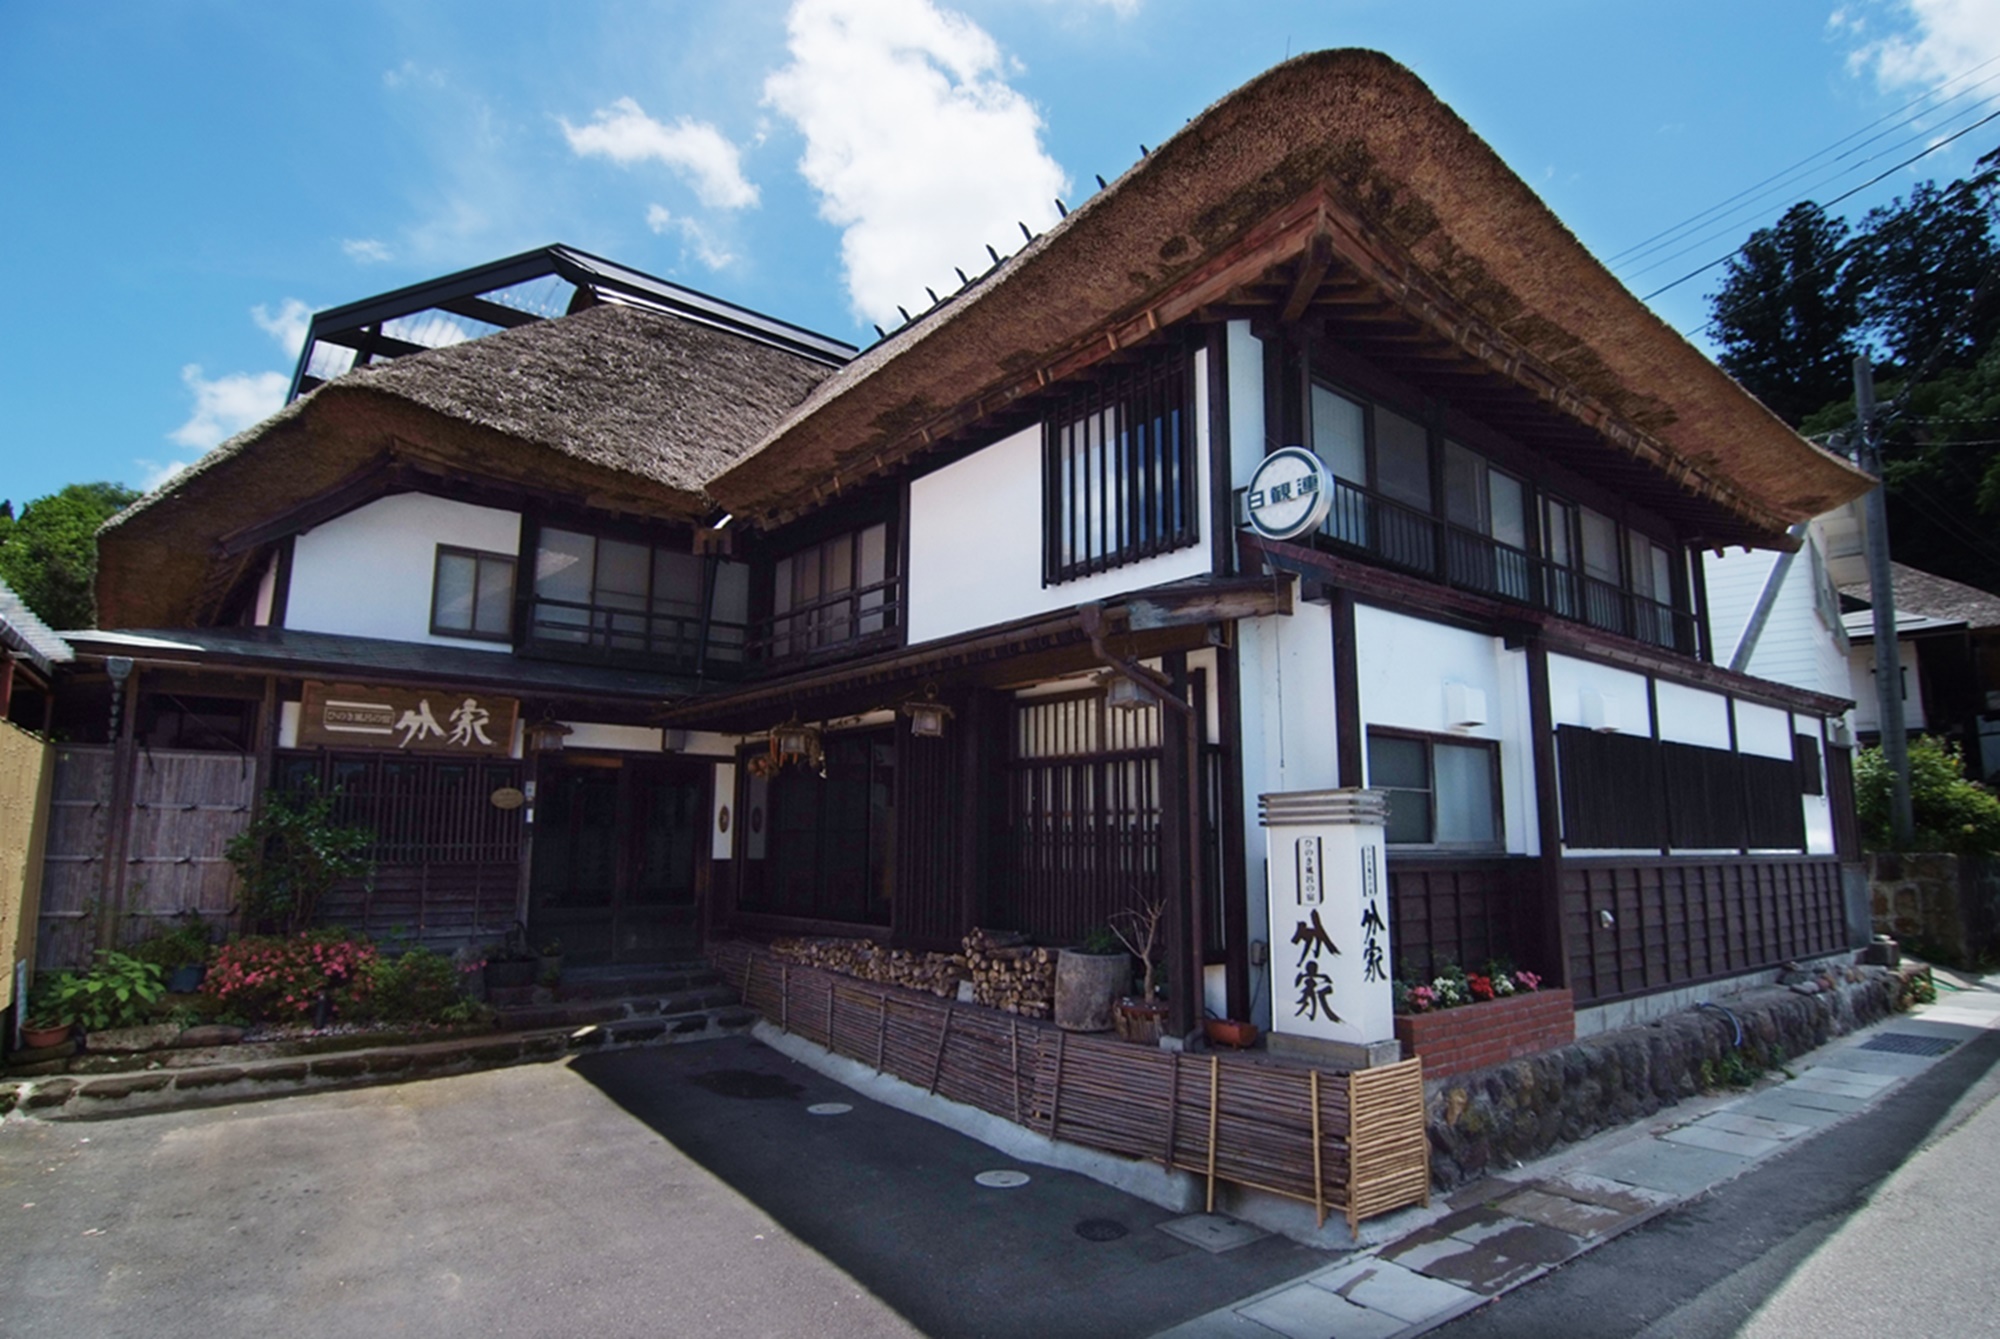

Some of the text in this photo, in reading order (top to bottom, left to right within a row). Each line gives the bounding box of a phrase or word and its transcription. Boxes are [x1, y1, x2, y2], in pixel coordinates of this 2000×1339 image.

[1304, 839, 1316, 902] ひのき風呂の宿
